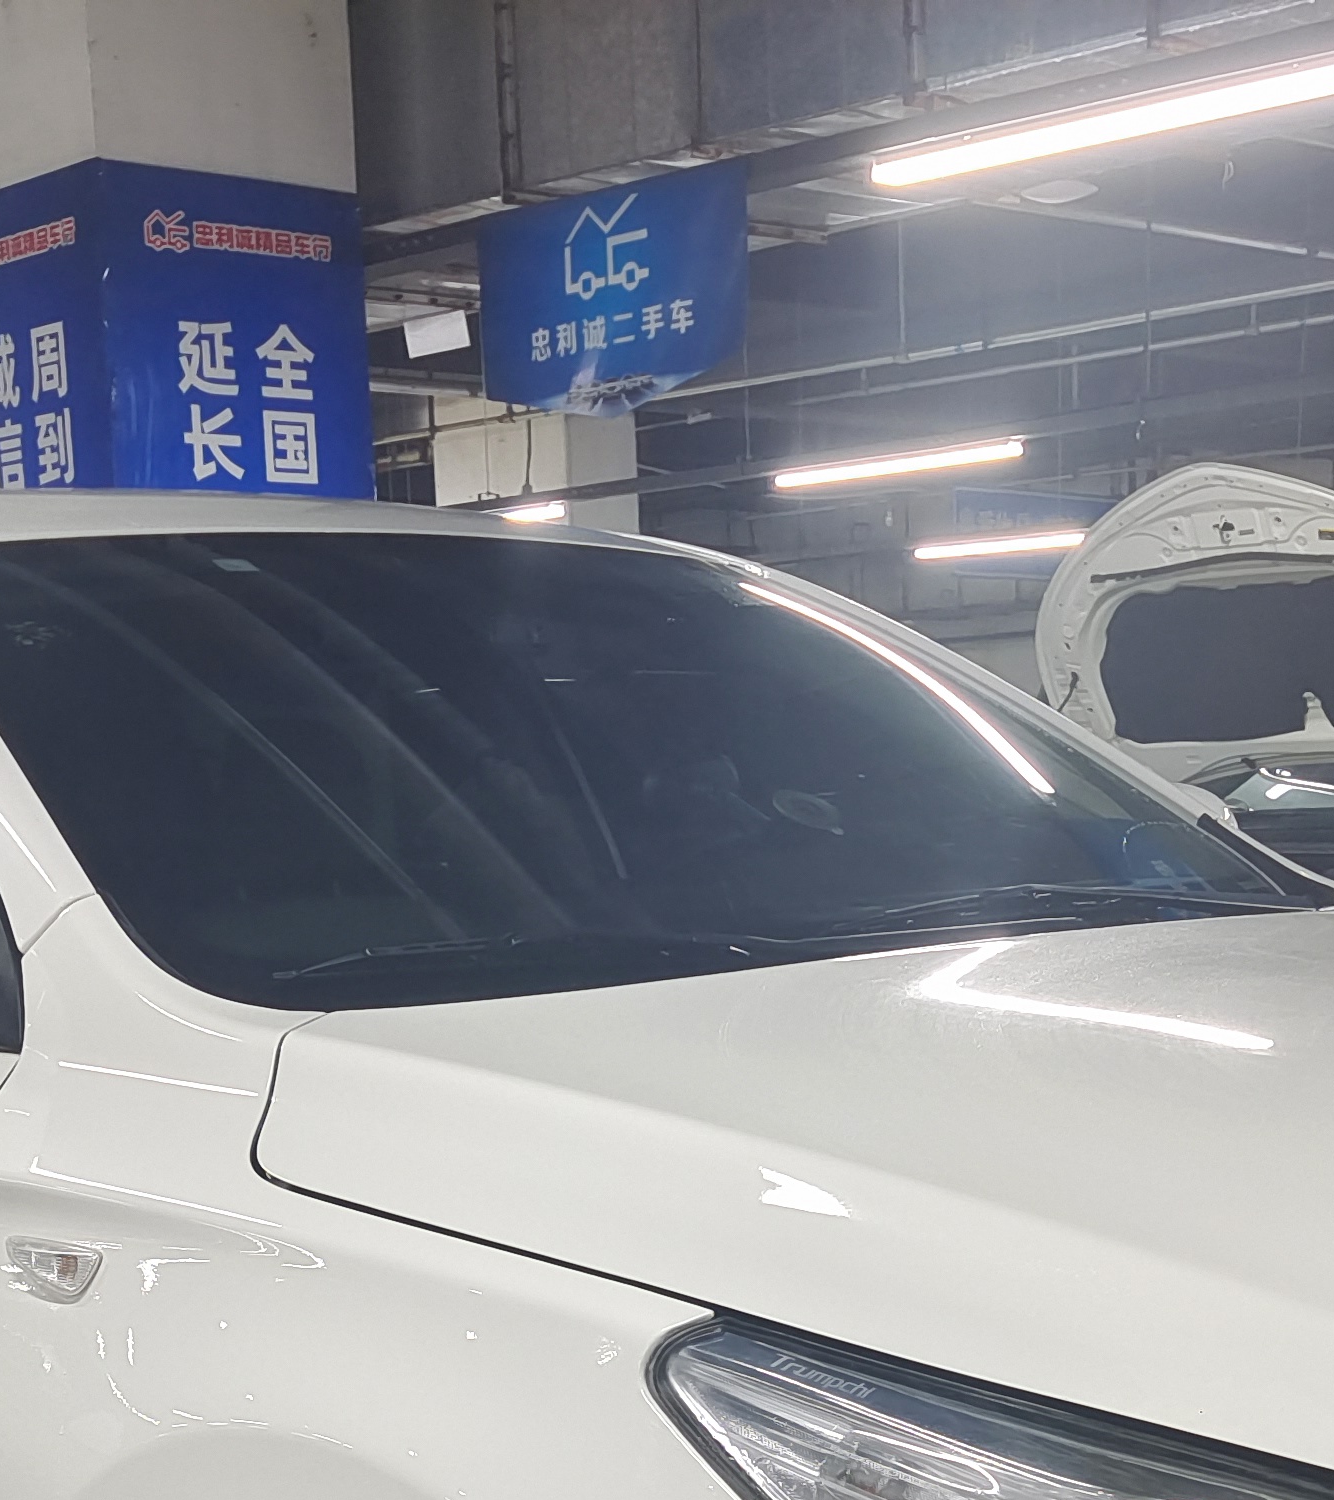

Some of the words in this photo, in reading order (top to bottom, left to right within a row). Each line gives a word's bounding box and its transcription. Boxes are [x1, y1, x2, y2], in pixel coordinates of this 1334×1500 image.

[194, 222, 331, 261] 忠利诚精品车行
[531, 299, 695, 361] 忠利诚二手车
[770, 1353, 876, 1399] Trumpchi
